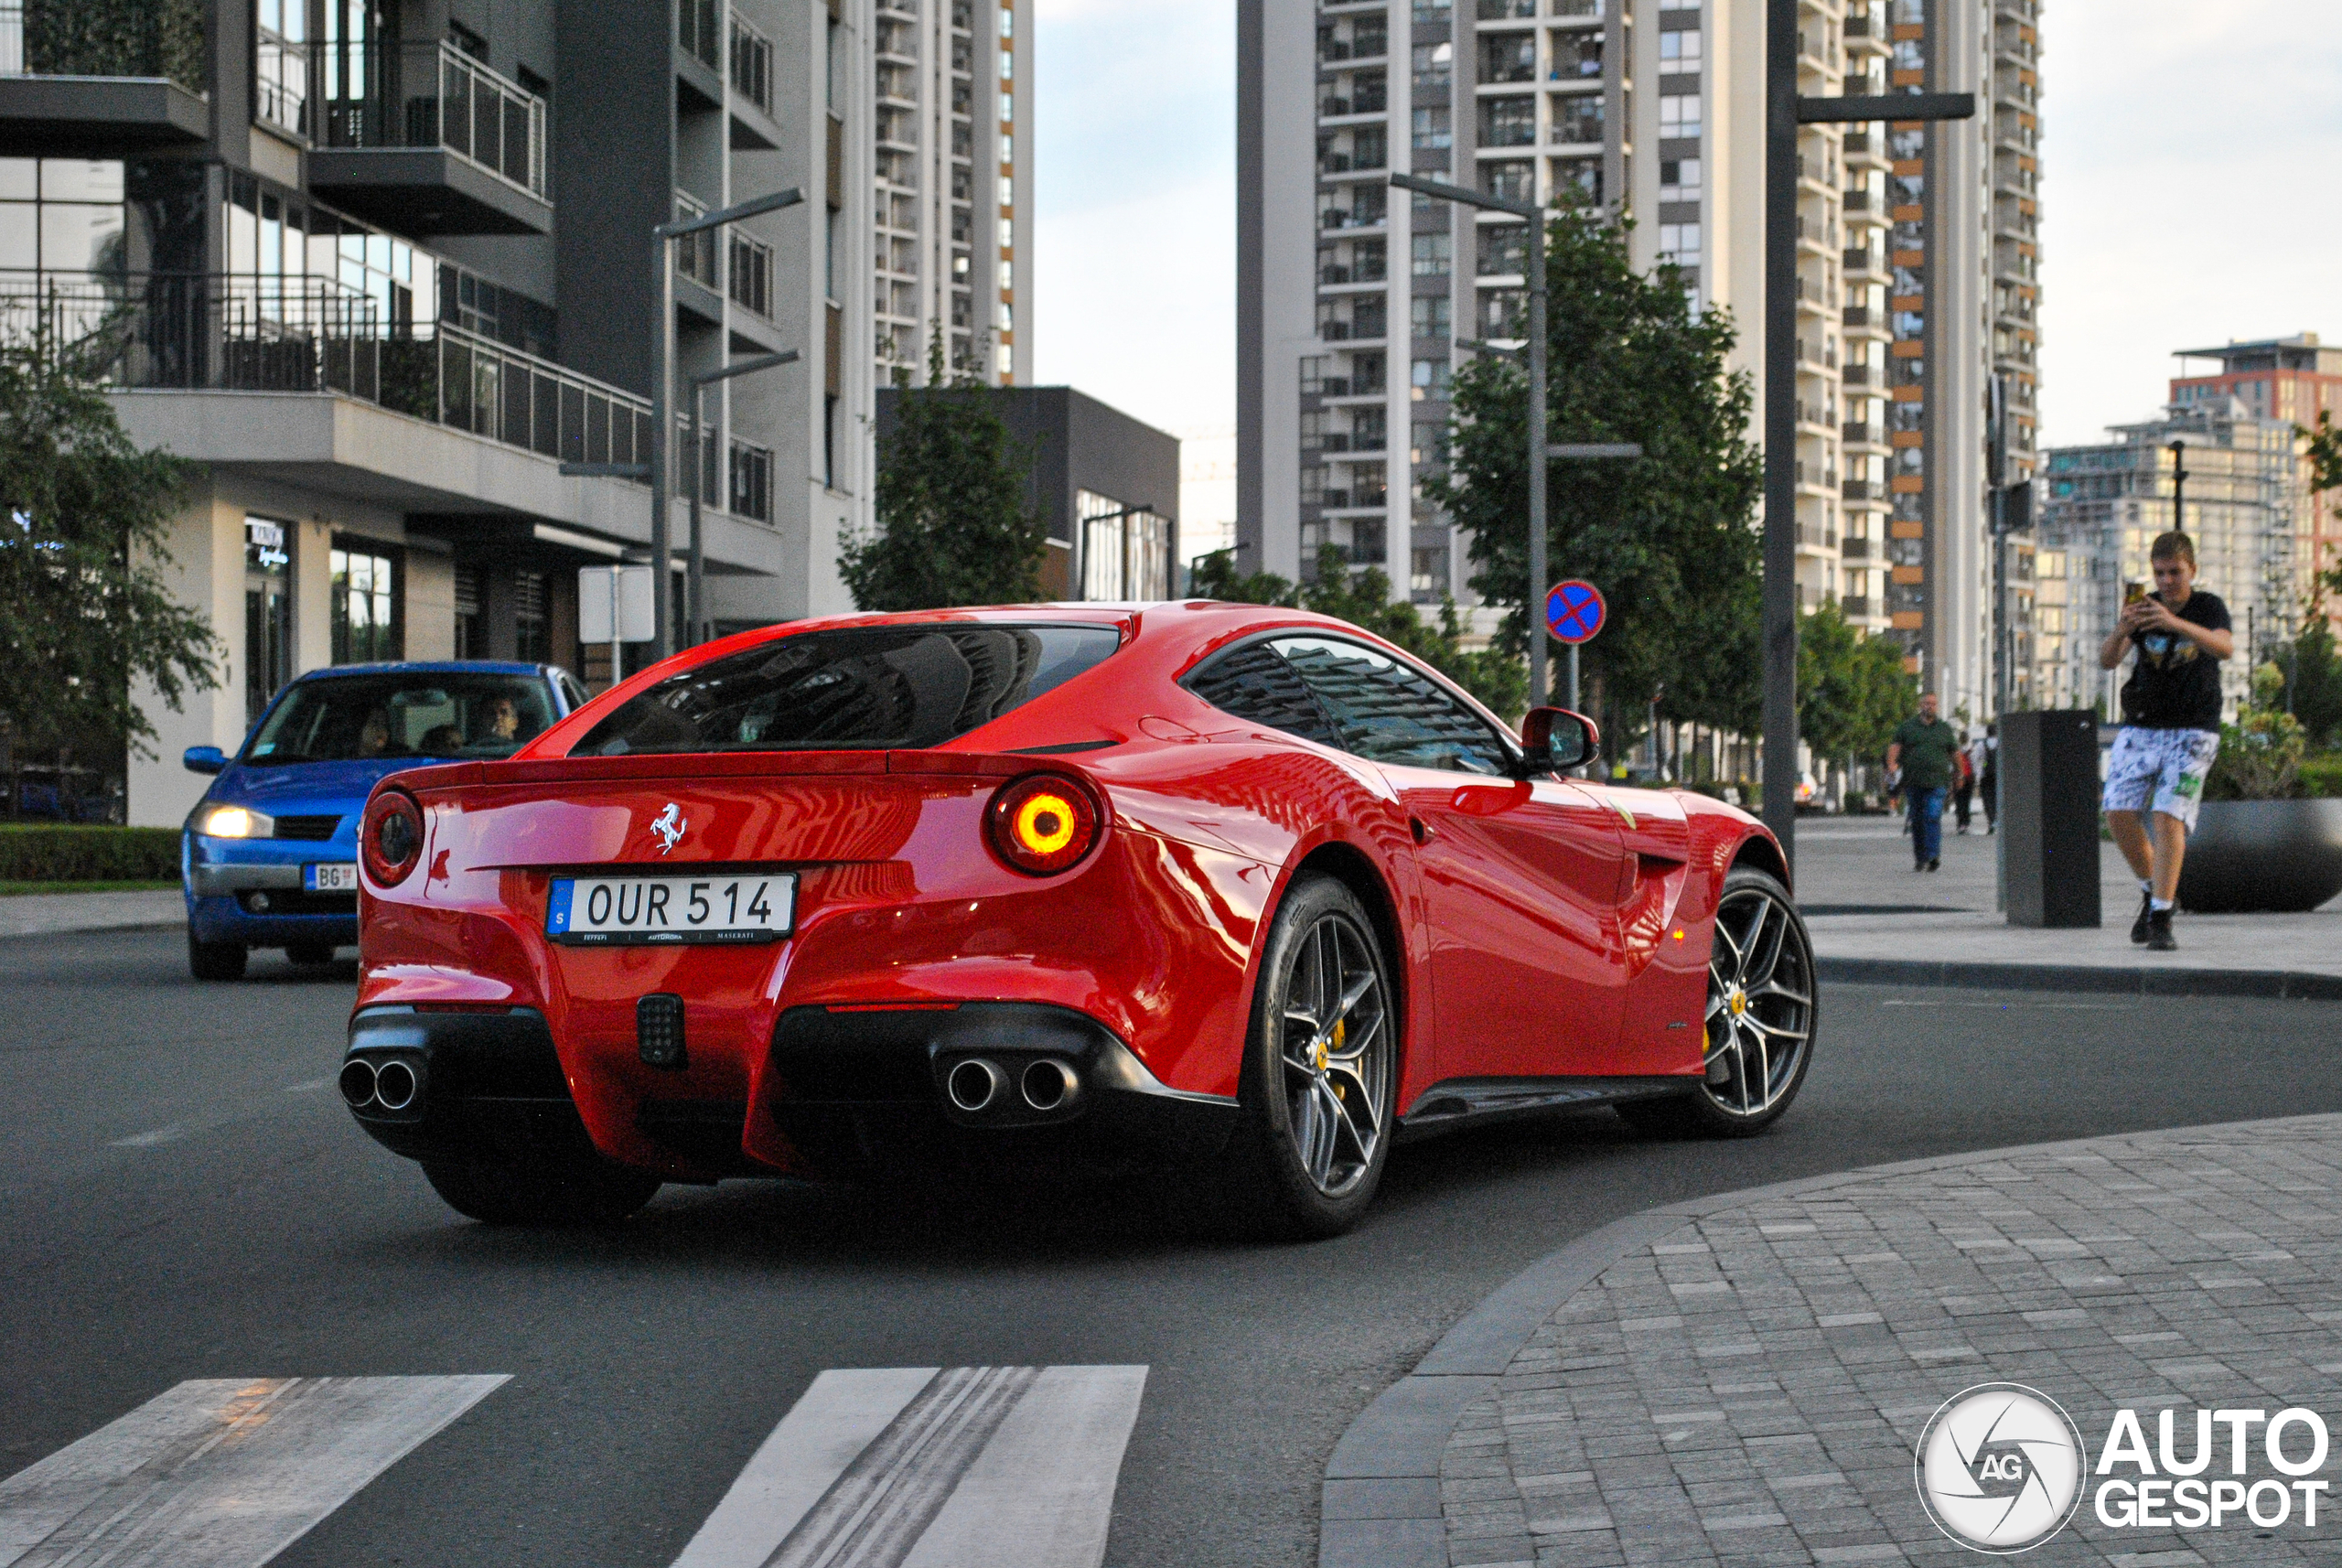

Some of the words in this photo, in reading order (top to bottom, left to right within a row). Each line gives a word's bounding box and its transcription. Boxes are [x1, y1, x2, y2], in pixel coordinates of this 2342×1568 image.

[319, 867, 340, 886] BG
[588, 884, 670, 926] OUR
[687, 882, 772, 925] 514
[555, 913, 564, 925] S
